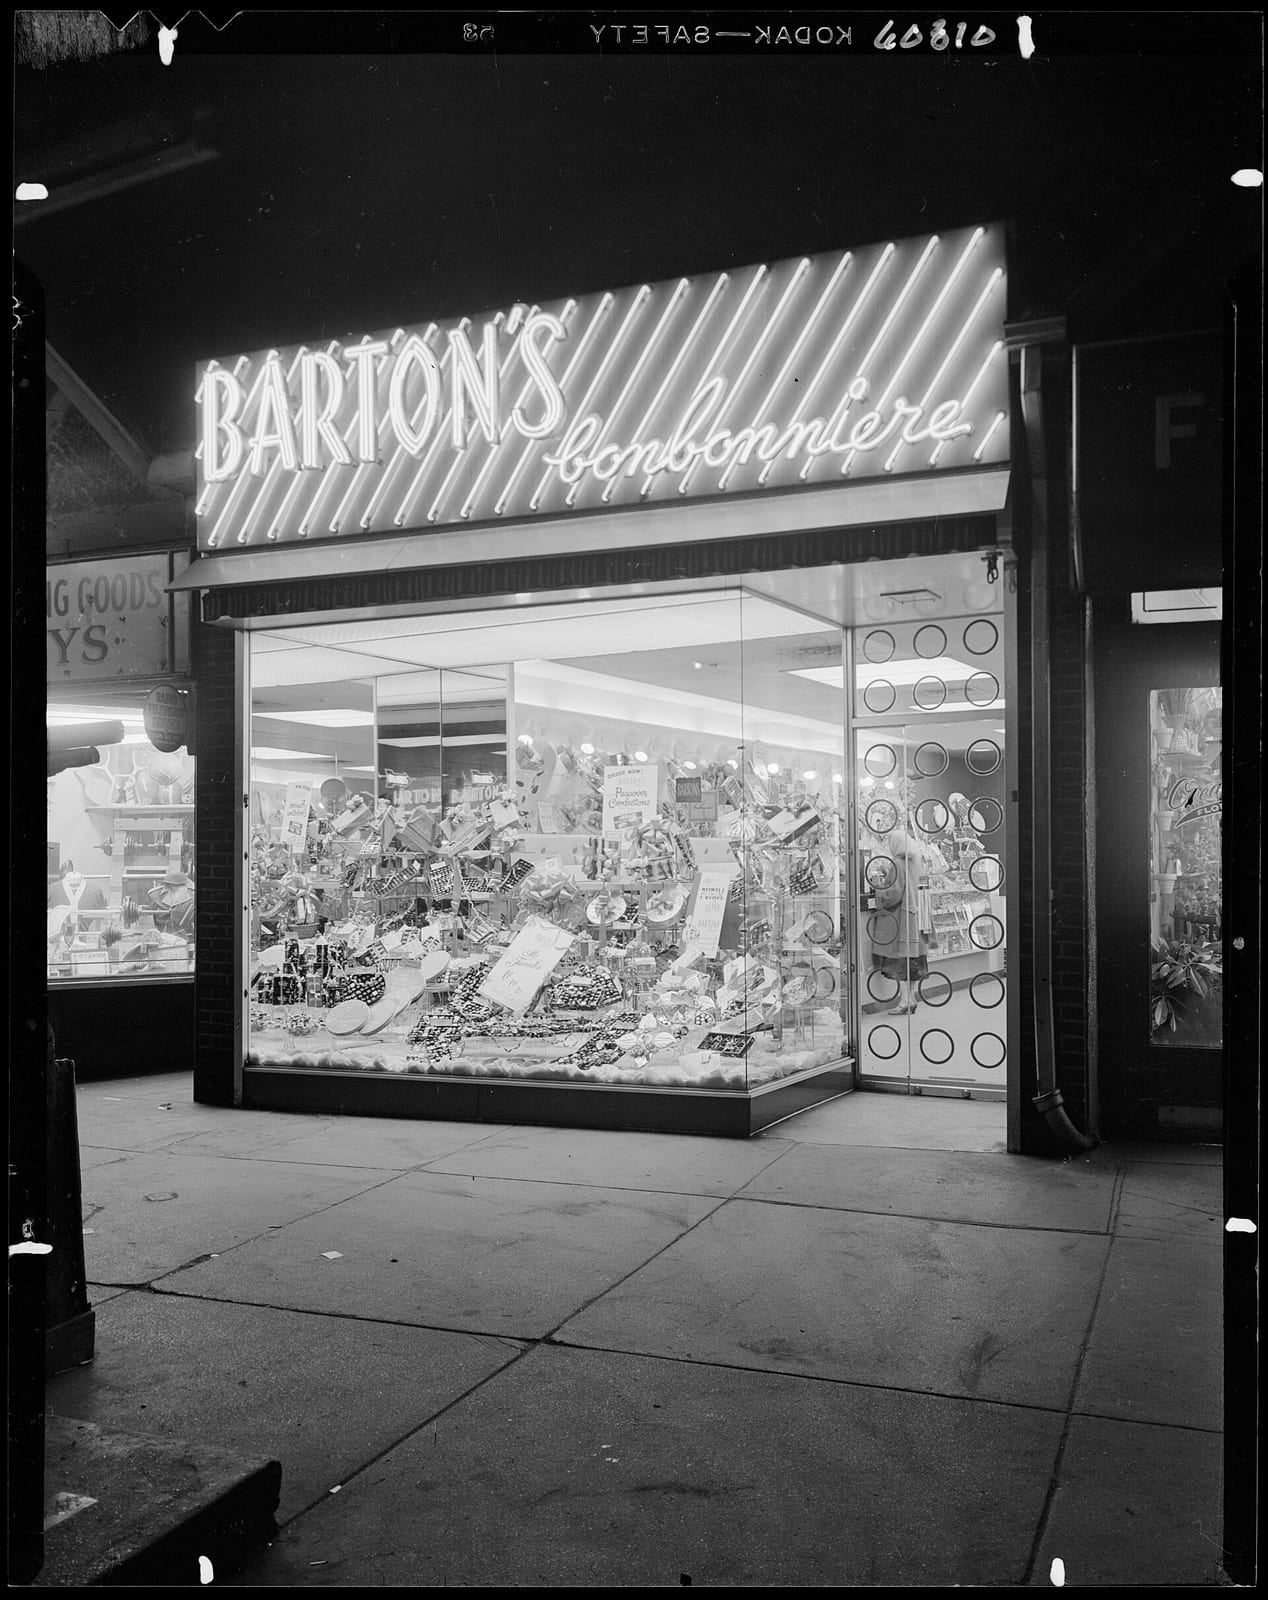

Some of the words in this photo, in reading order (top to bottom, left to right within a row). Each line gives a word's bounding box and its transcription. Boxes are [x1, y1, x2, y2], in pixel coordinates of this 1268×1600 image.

[873, 19, 996, 51] 60810
[202, 303, 568, 483] BARTON'S
[78, 570, 161, 615] GOODS
[1197, 803, 1222, 815] FLO
